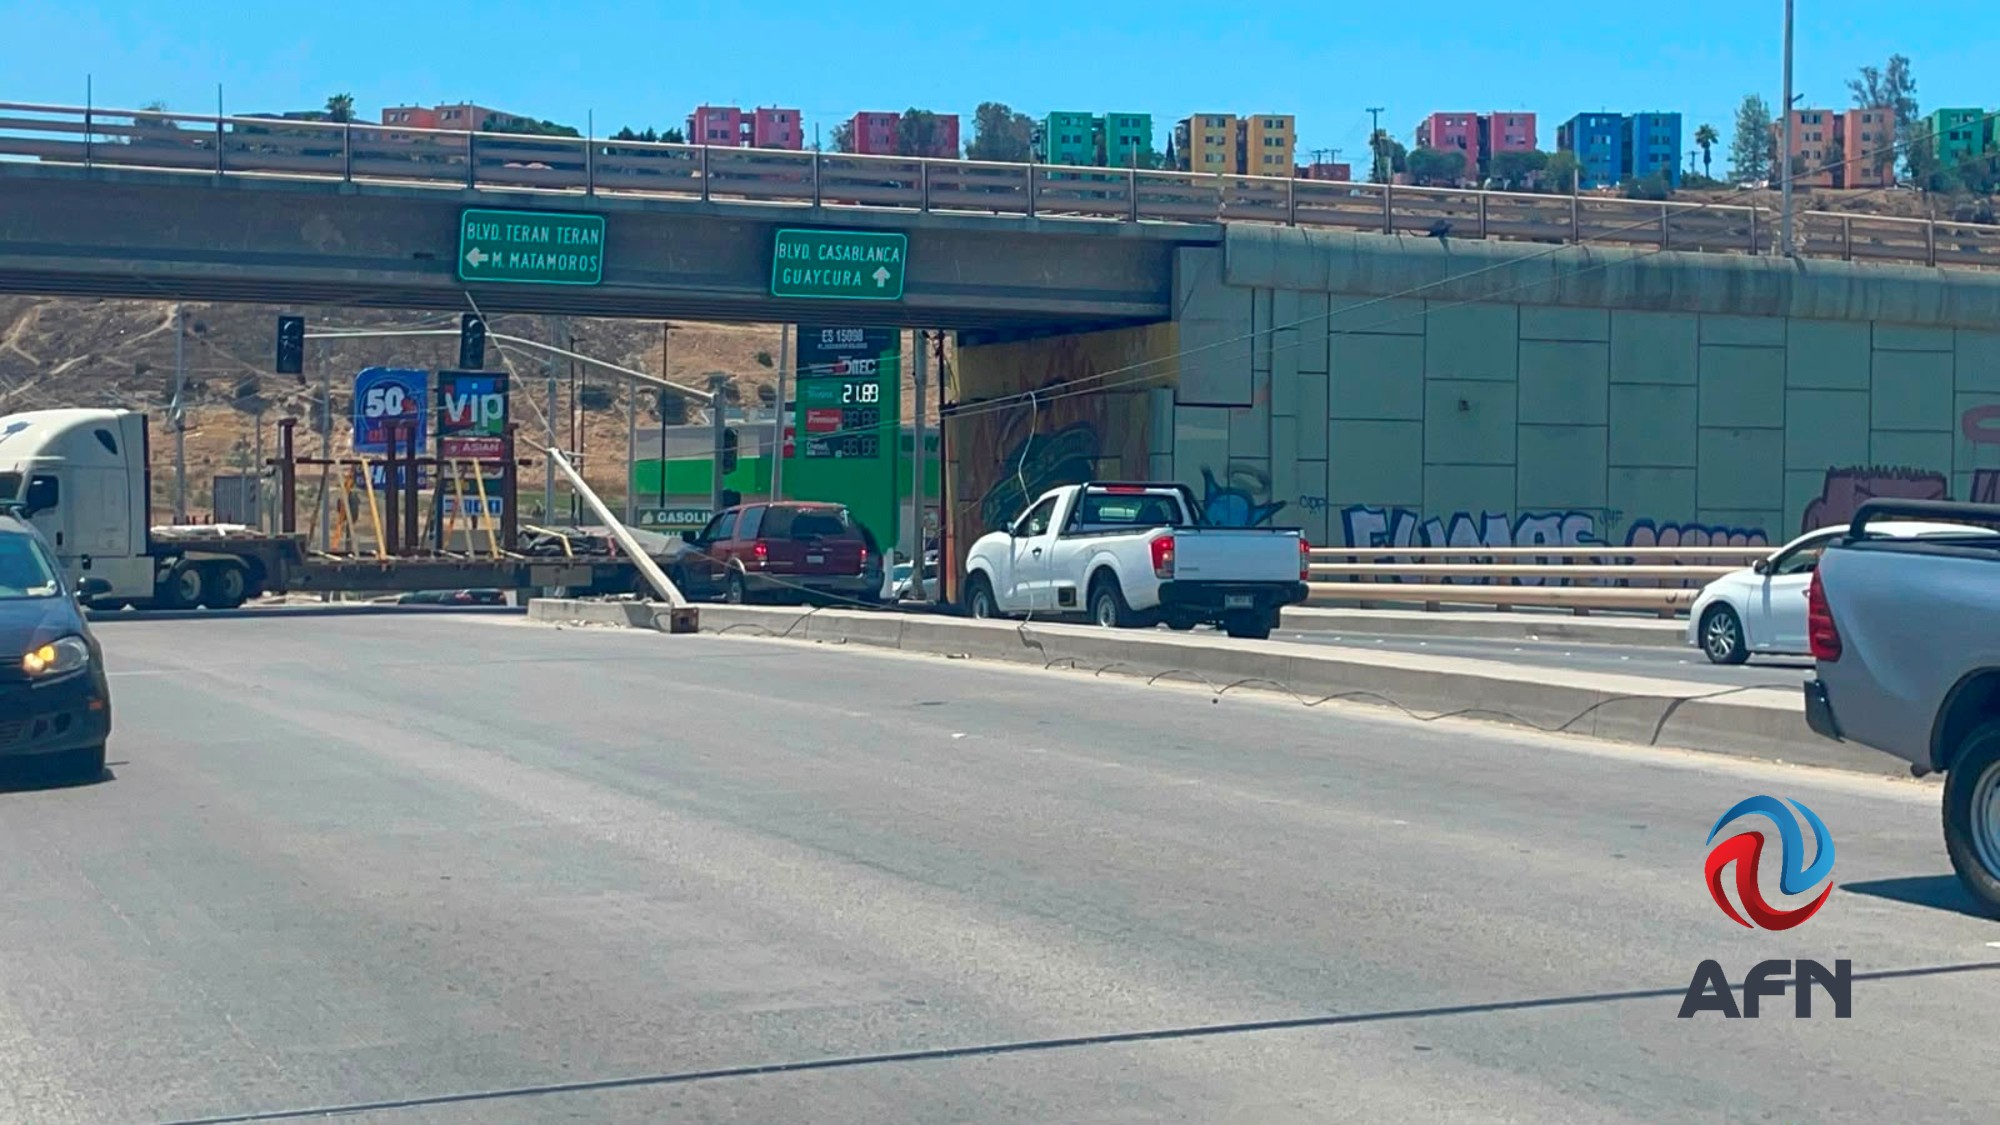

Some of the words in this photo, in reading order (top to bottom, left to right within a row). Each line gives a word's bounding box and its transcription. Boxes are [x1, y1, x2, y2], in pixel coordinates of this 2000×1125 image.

[467, 222, 501, 241] BLVD.
[506, 224, 549, 243] TERAN
[557, 227, 599, 245] TERAN
[509, 252, 598, 272] MATAMOROS
[818, 244, 900, 263] CASABLANCA
[783, 268, 861, 286] GUAYCURA
[842, 384, 879, 403] 21.89
[445, 383, 504, 427] vip
